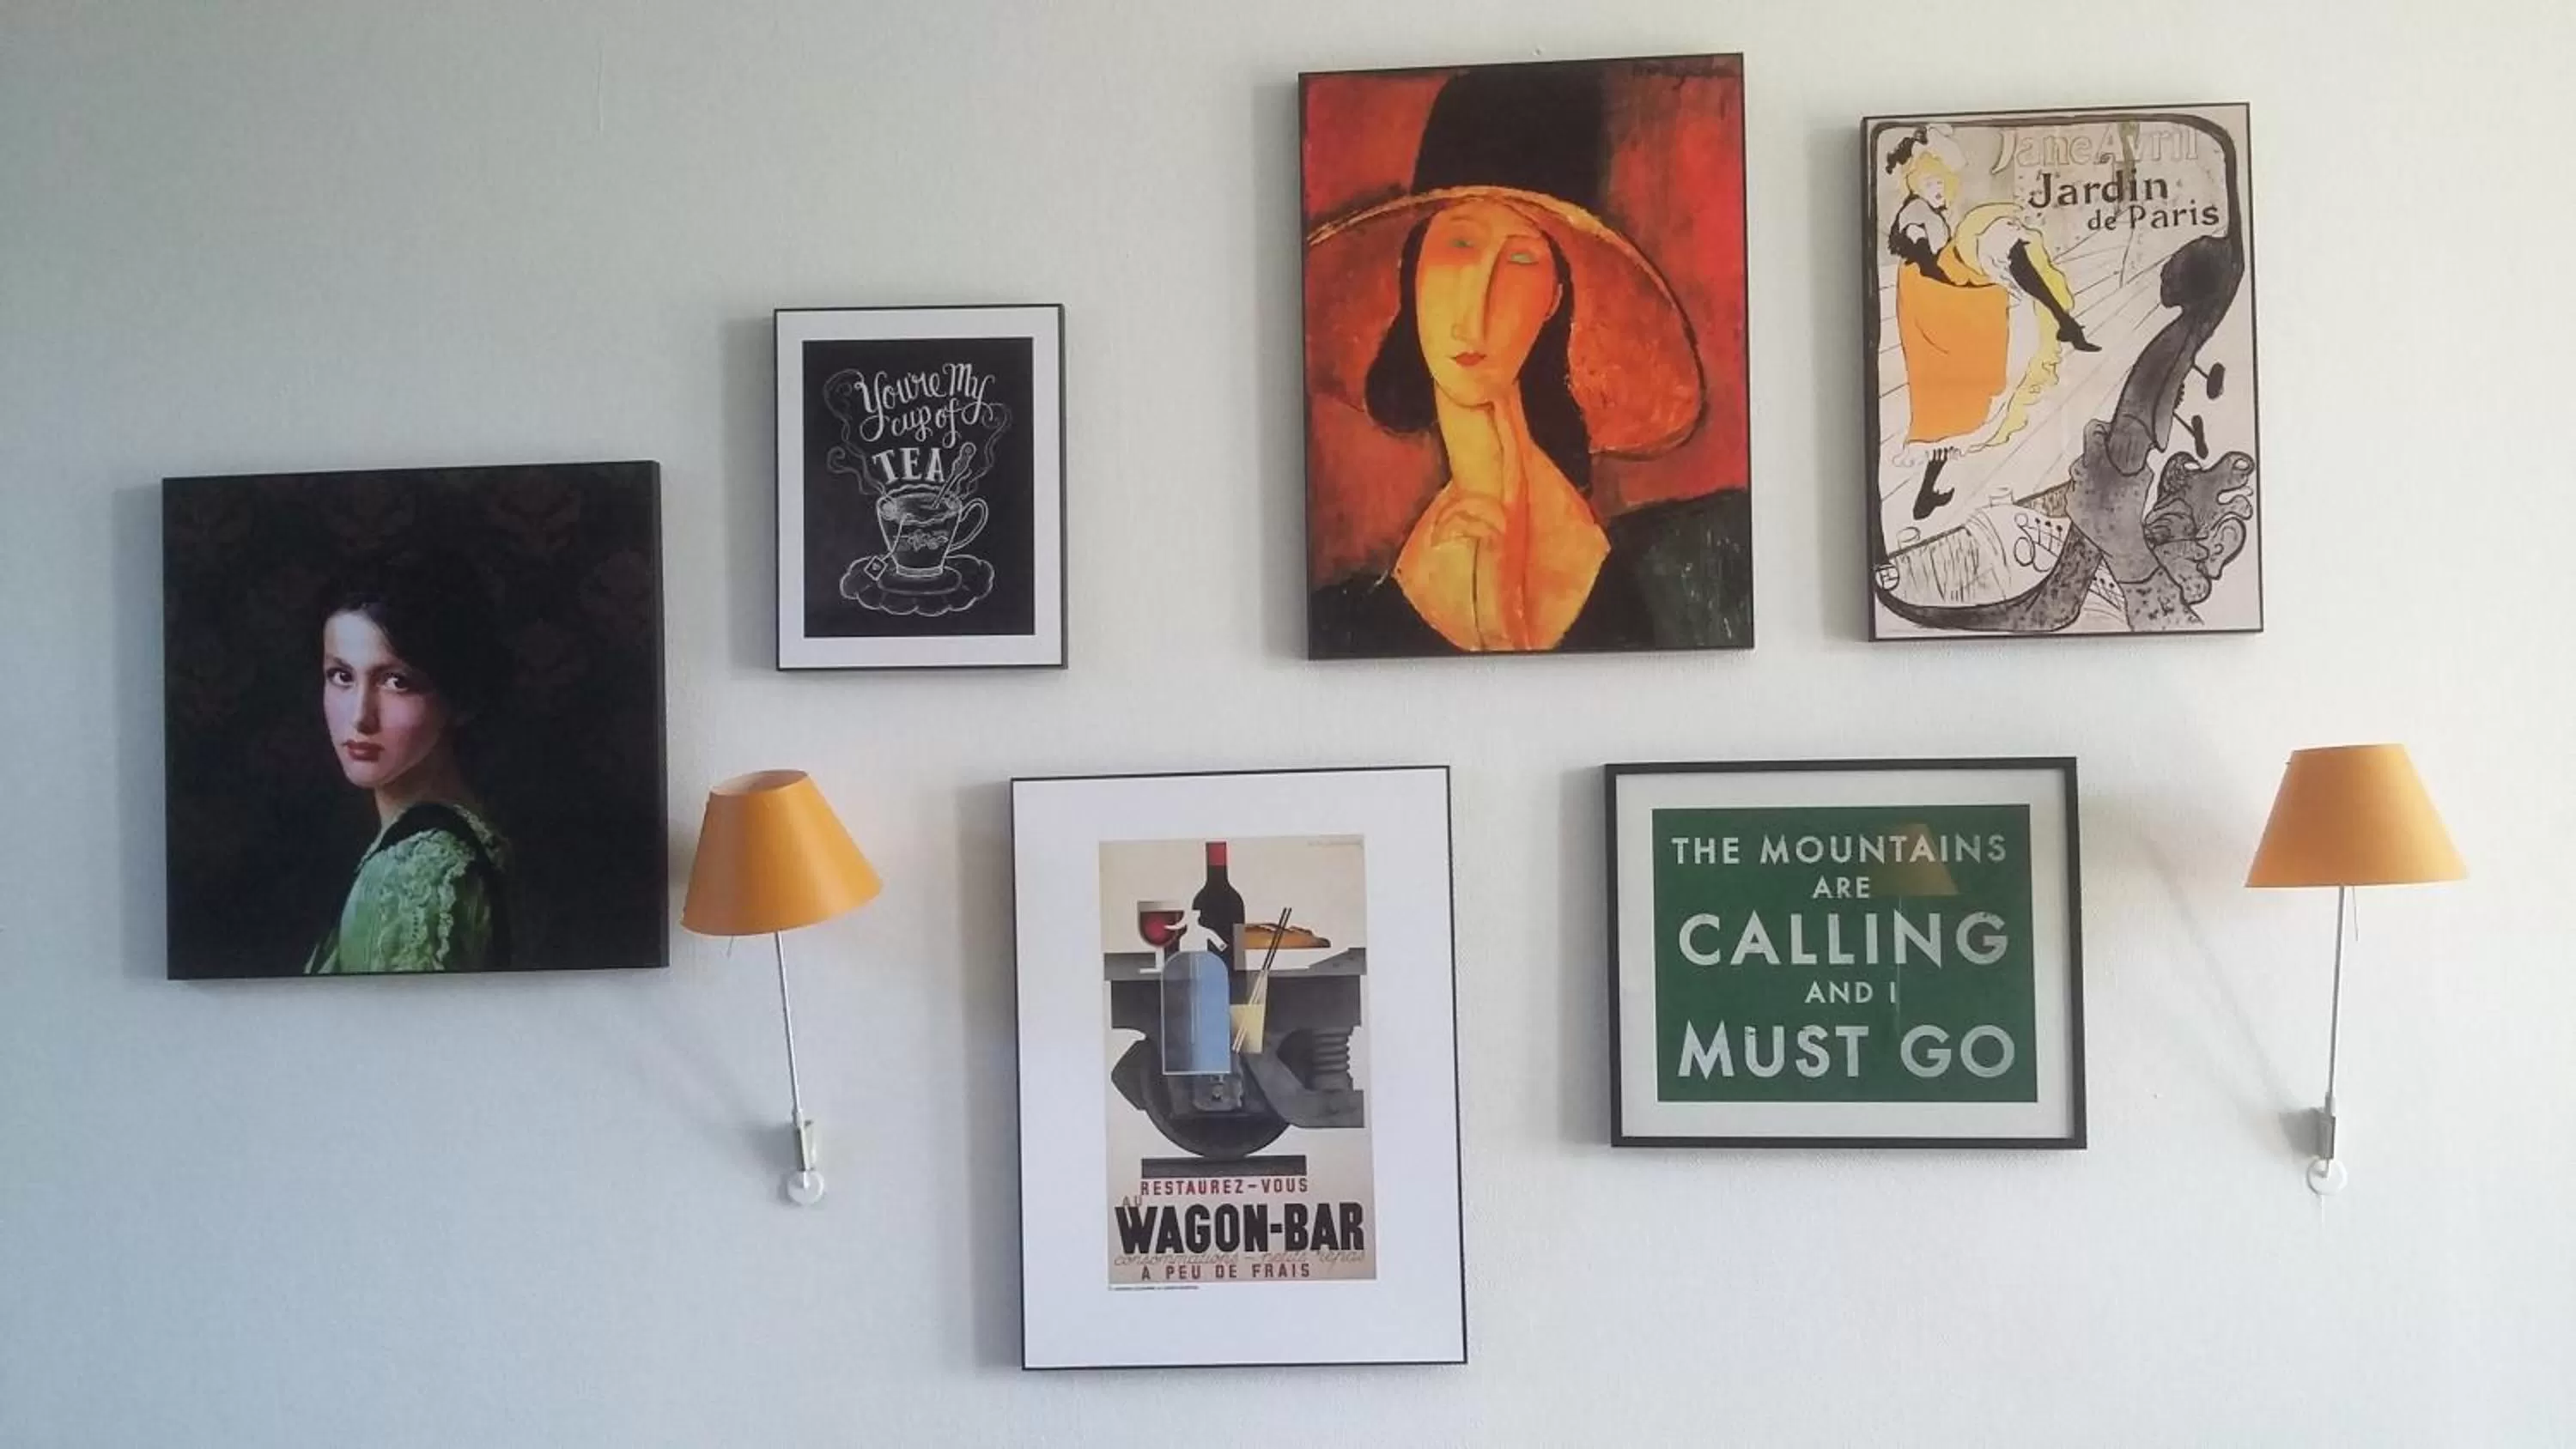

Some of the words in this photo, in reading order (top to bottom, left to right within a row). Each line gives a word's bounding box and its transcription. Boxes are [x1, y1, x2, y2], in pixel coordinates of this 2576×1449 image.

[1990, 129, 2093, 175] Jane
[2093, 122, 2199, 164] Avril
[2027, 168, 2169, 209] Jardin
[2087, 209, 2117, 230] de
[2129, 199, 2221, 228] Paris
[943, 362, 996, 425] My
[892, 405, 933, 442] cup
[935, 397, 961, 448] of
[872, 447, 945, 485] TEA
[1671, 837, 1741, 864] THE
[1760, 834, 2007, 864] MOUNTAINS
[1812, 876, 1870, 899] ARE
[1679, 909, 2008, 968] CALLING
[1805, 981, 1874, 1003] AND
[1890, 981, 1897, 1003] I
[1678, 1019, 1869, 1080] MUST
[1900, 1024, 2015, 1078] GO
[1121, 1194, 1143, 1206] AU
[1140, 1178, 1309, 1196] RESTAUREZ-VOUS
[1115, 1202, 1365, 1254] WAGON-BAR
[1165, 1264, 1201, 1280] PEU
[1215, 1264, 1237, 1278] DE
[1252, 1263, 1310, 1278] FRAIS
